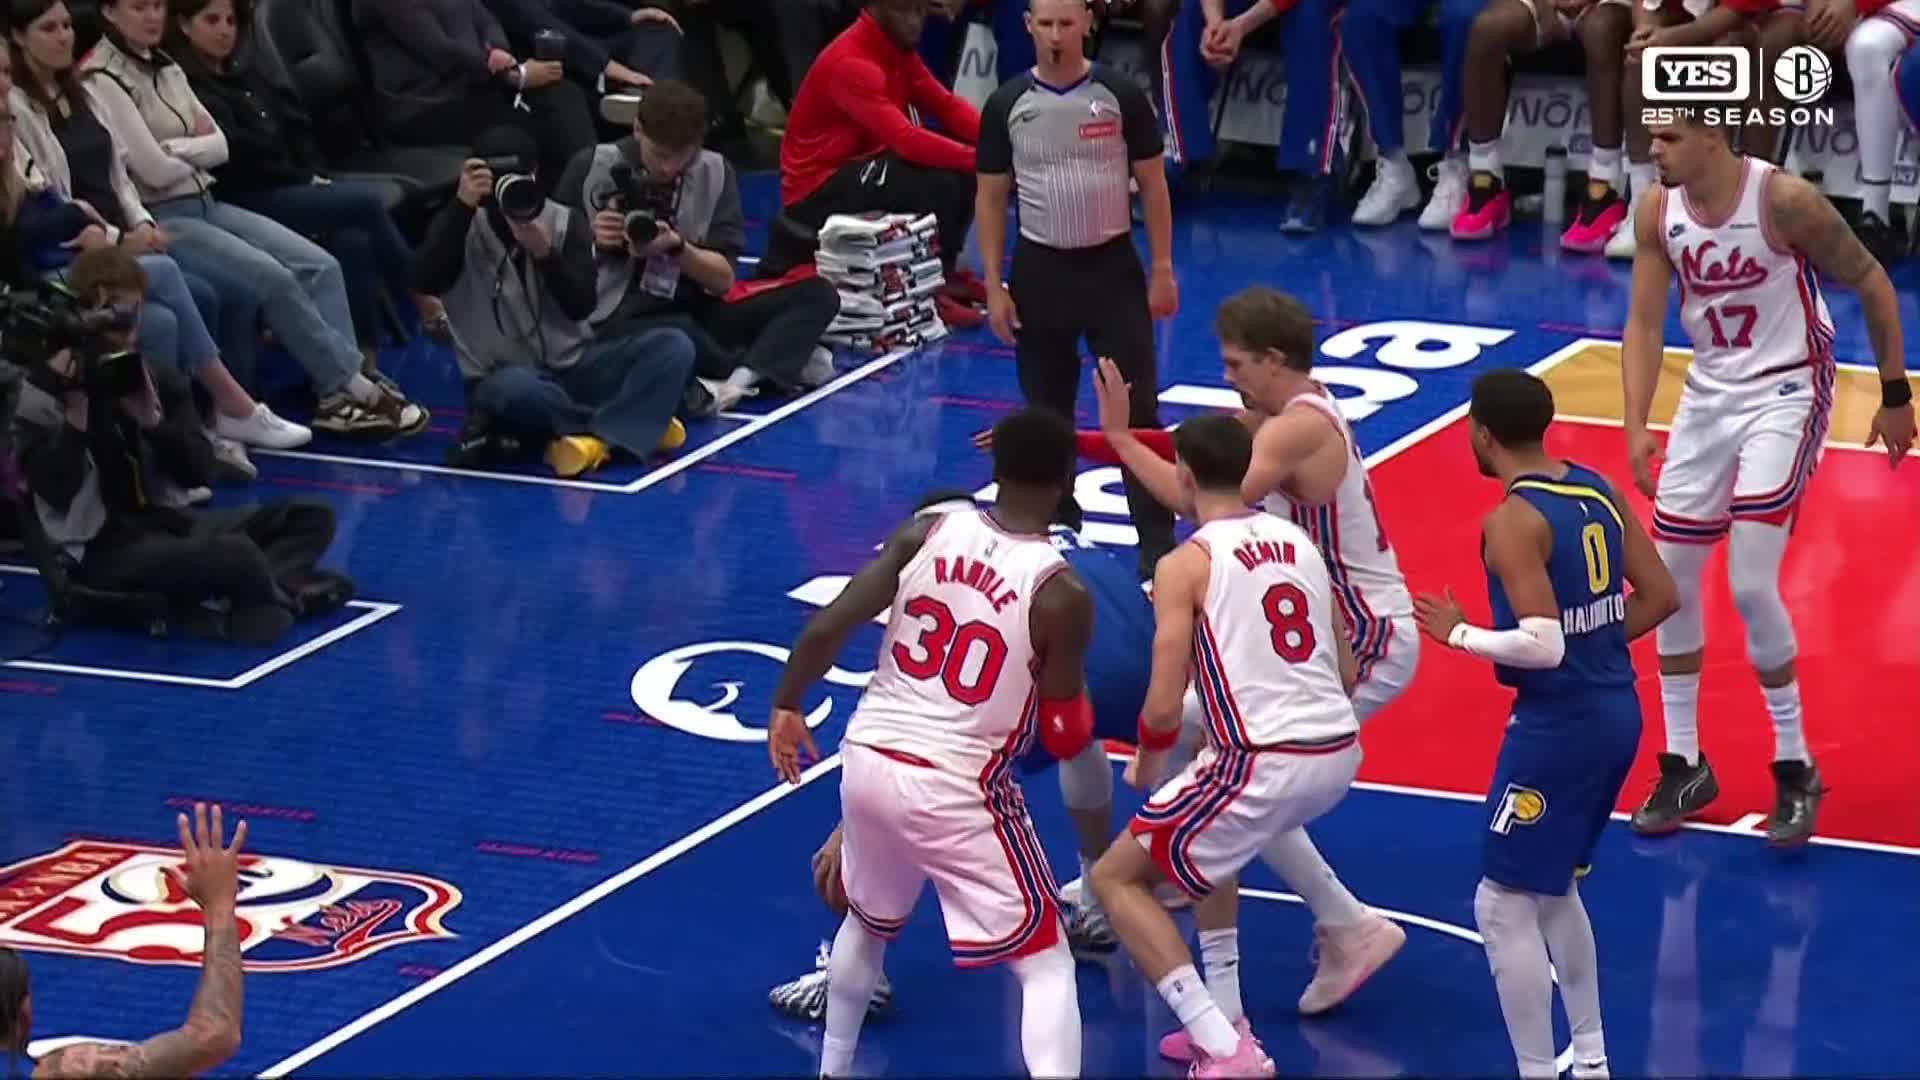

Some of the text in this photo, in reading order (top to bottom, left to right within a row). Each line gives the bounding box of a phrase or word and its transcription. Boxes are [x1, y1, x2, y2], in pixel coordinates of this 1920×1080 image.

[1681, 240, 1769, 296] Nets
[1704, 304, 1758, 348] 17
[934, 555, 1019, 615] RANDLE
[1582, 522, 1610, 594] 0
[891, 594, 1009, 707] 30
[1261, 582, 1316, 664] 8
